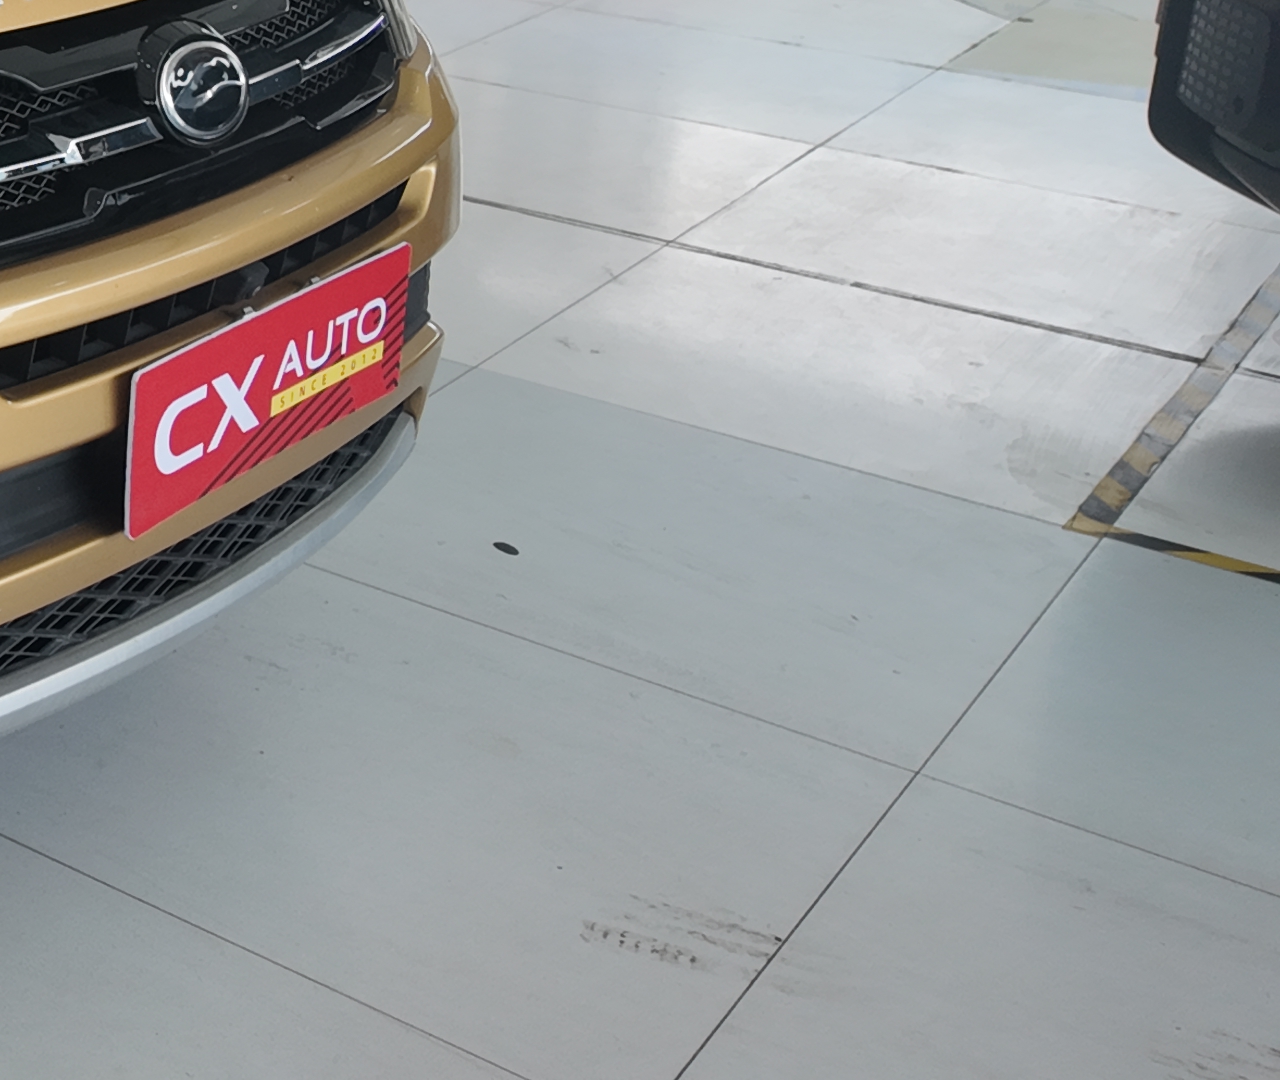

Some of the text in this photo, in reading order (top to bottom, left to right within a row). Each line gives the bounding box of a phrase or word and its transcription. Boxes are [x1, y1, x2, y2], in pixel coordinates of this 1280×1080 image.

[154, 296, 387, 475] CX AUTO
[280, 347, 378, 409] SINCE 2012
